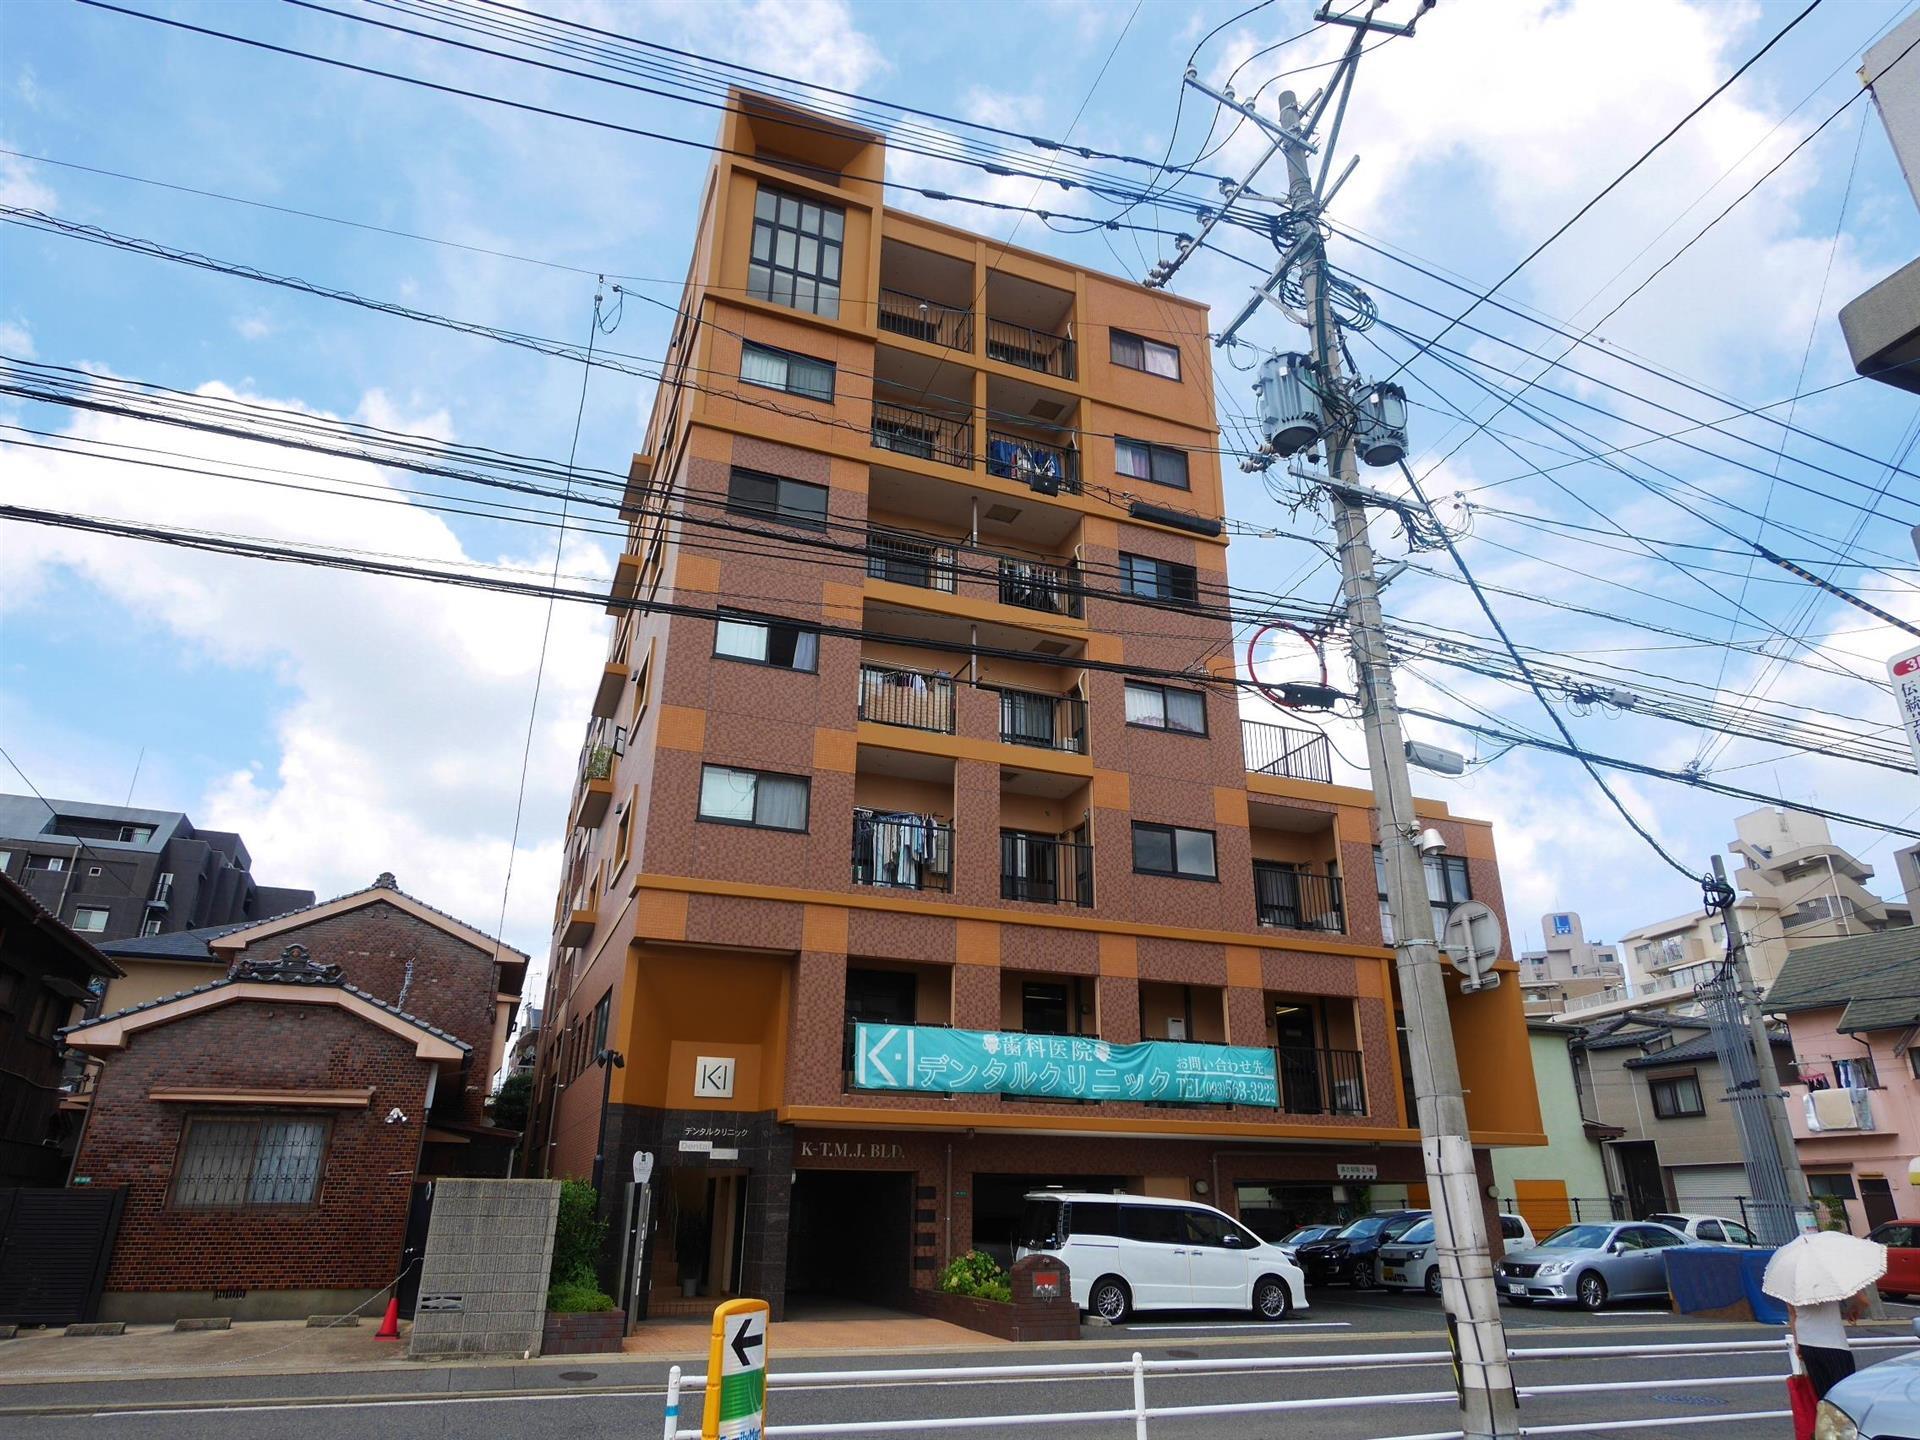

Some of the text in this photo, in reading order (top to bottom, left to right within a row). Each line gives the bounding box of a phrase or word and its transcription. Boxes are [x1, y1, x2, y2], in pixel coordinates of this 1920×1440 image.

[1002, 1037, 1093, 1062] 歯科医院
[1176, 1056, 1264, 1075] お問い合わせ先
[918, 1054, 1170, 1098] デンタルクリニック
[684, 1127, 749, 1137] デンタルクリニック
[870, 1143, 905, 1159] BLD.
